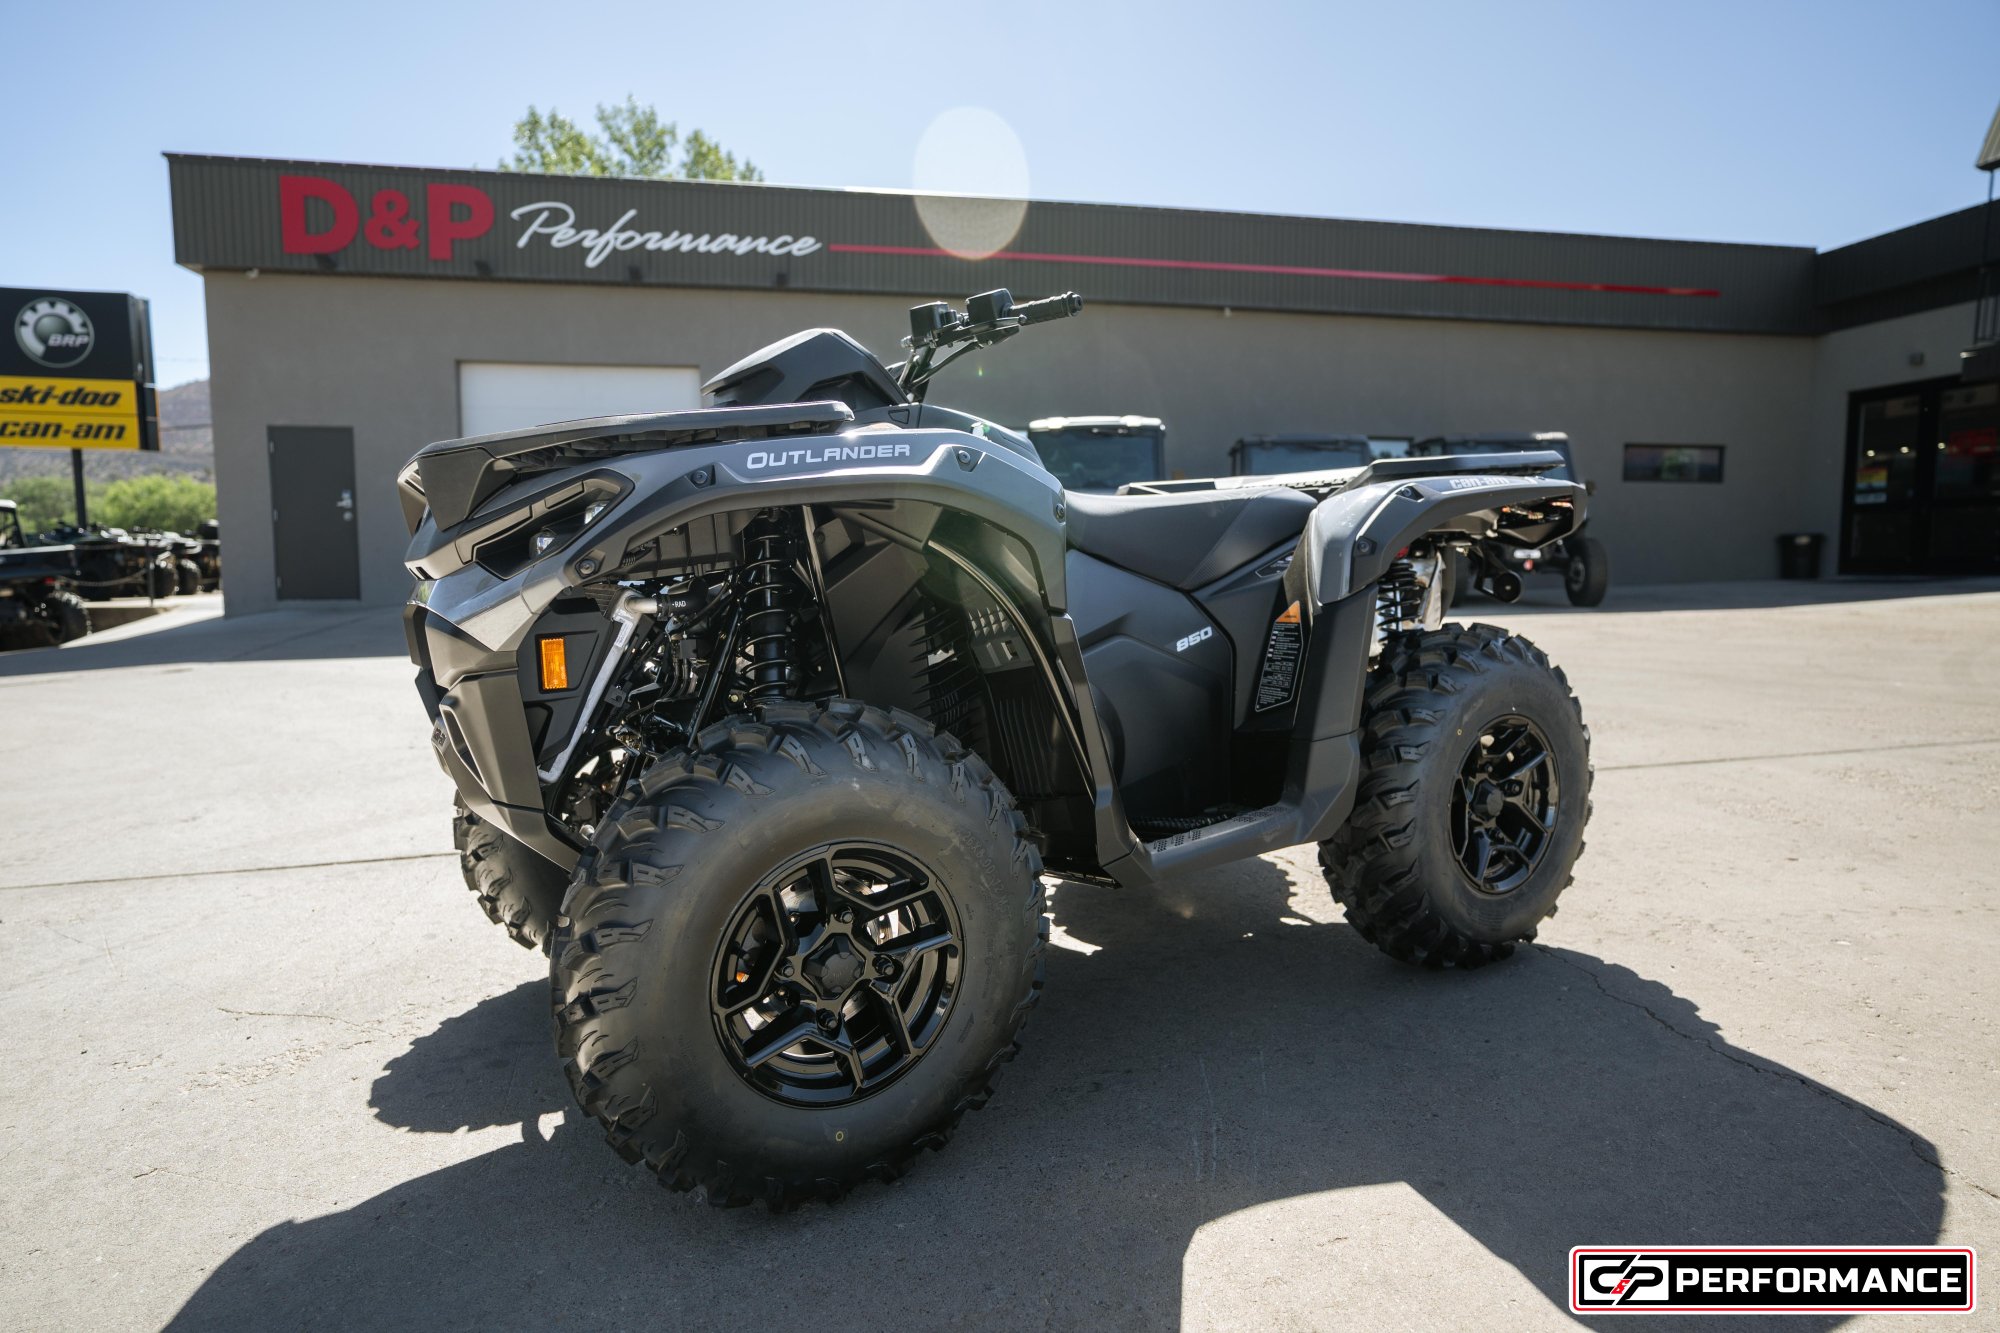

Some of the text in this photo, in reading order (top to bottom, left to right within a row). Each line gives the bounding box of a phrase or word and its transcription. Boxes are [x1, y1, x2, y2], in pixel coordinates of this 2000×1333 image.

[279, 175, 823, 269] D&P Performance
[48, 334, 90, 347] BRP
[1176, 626, 1213, 652] 850
